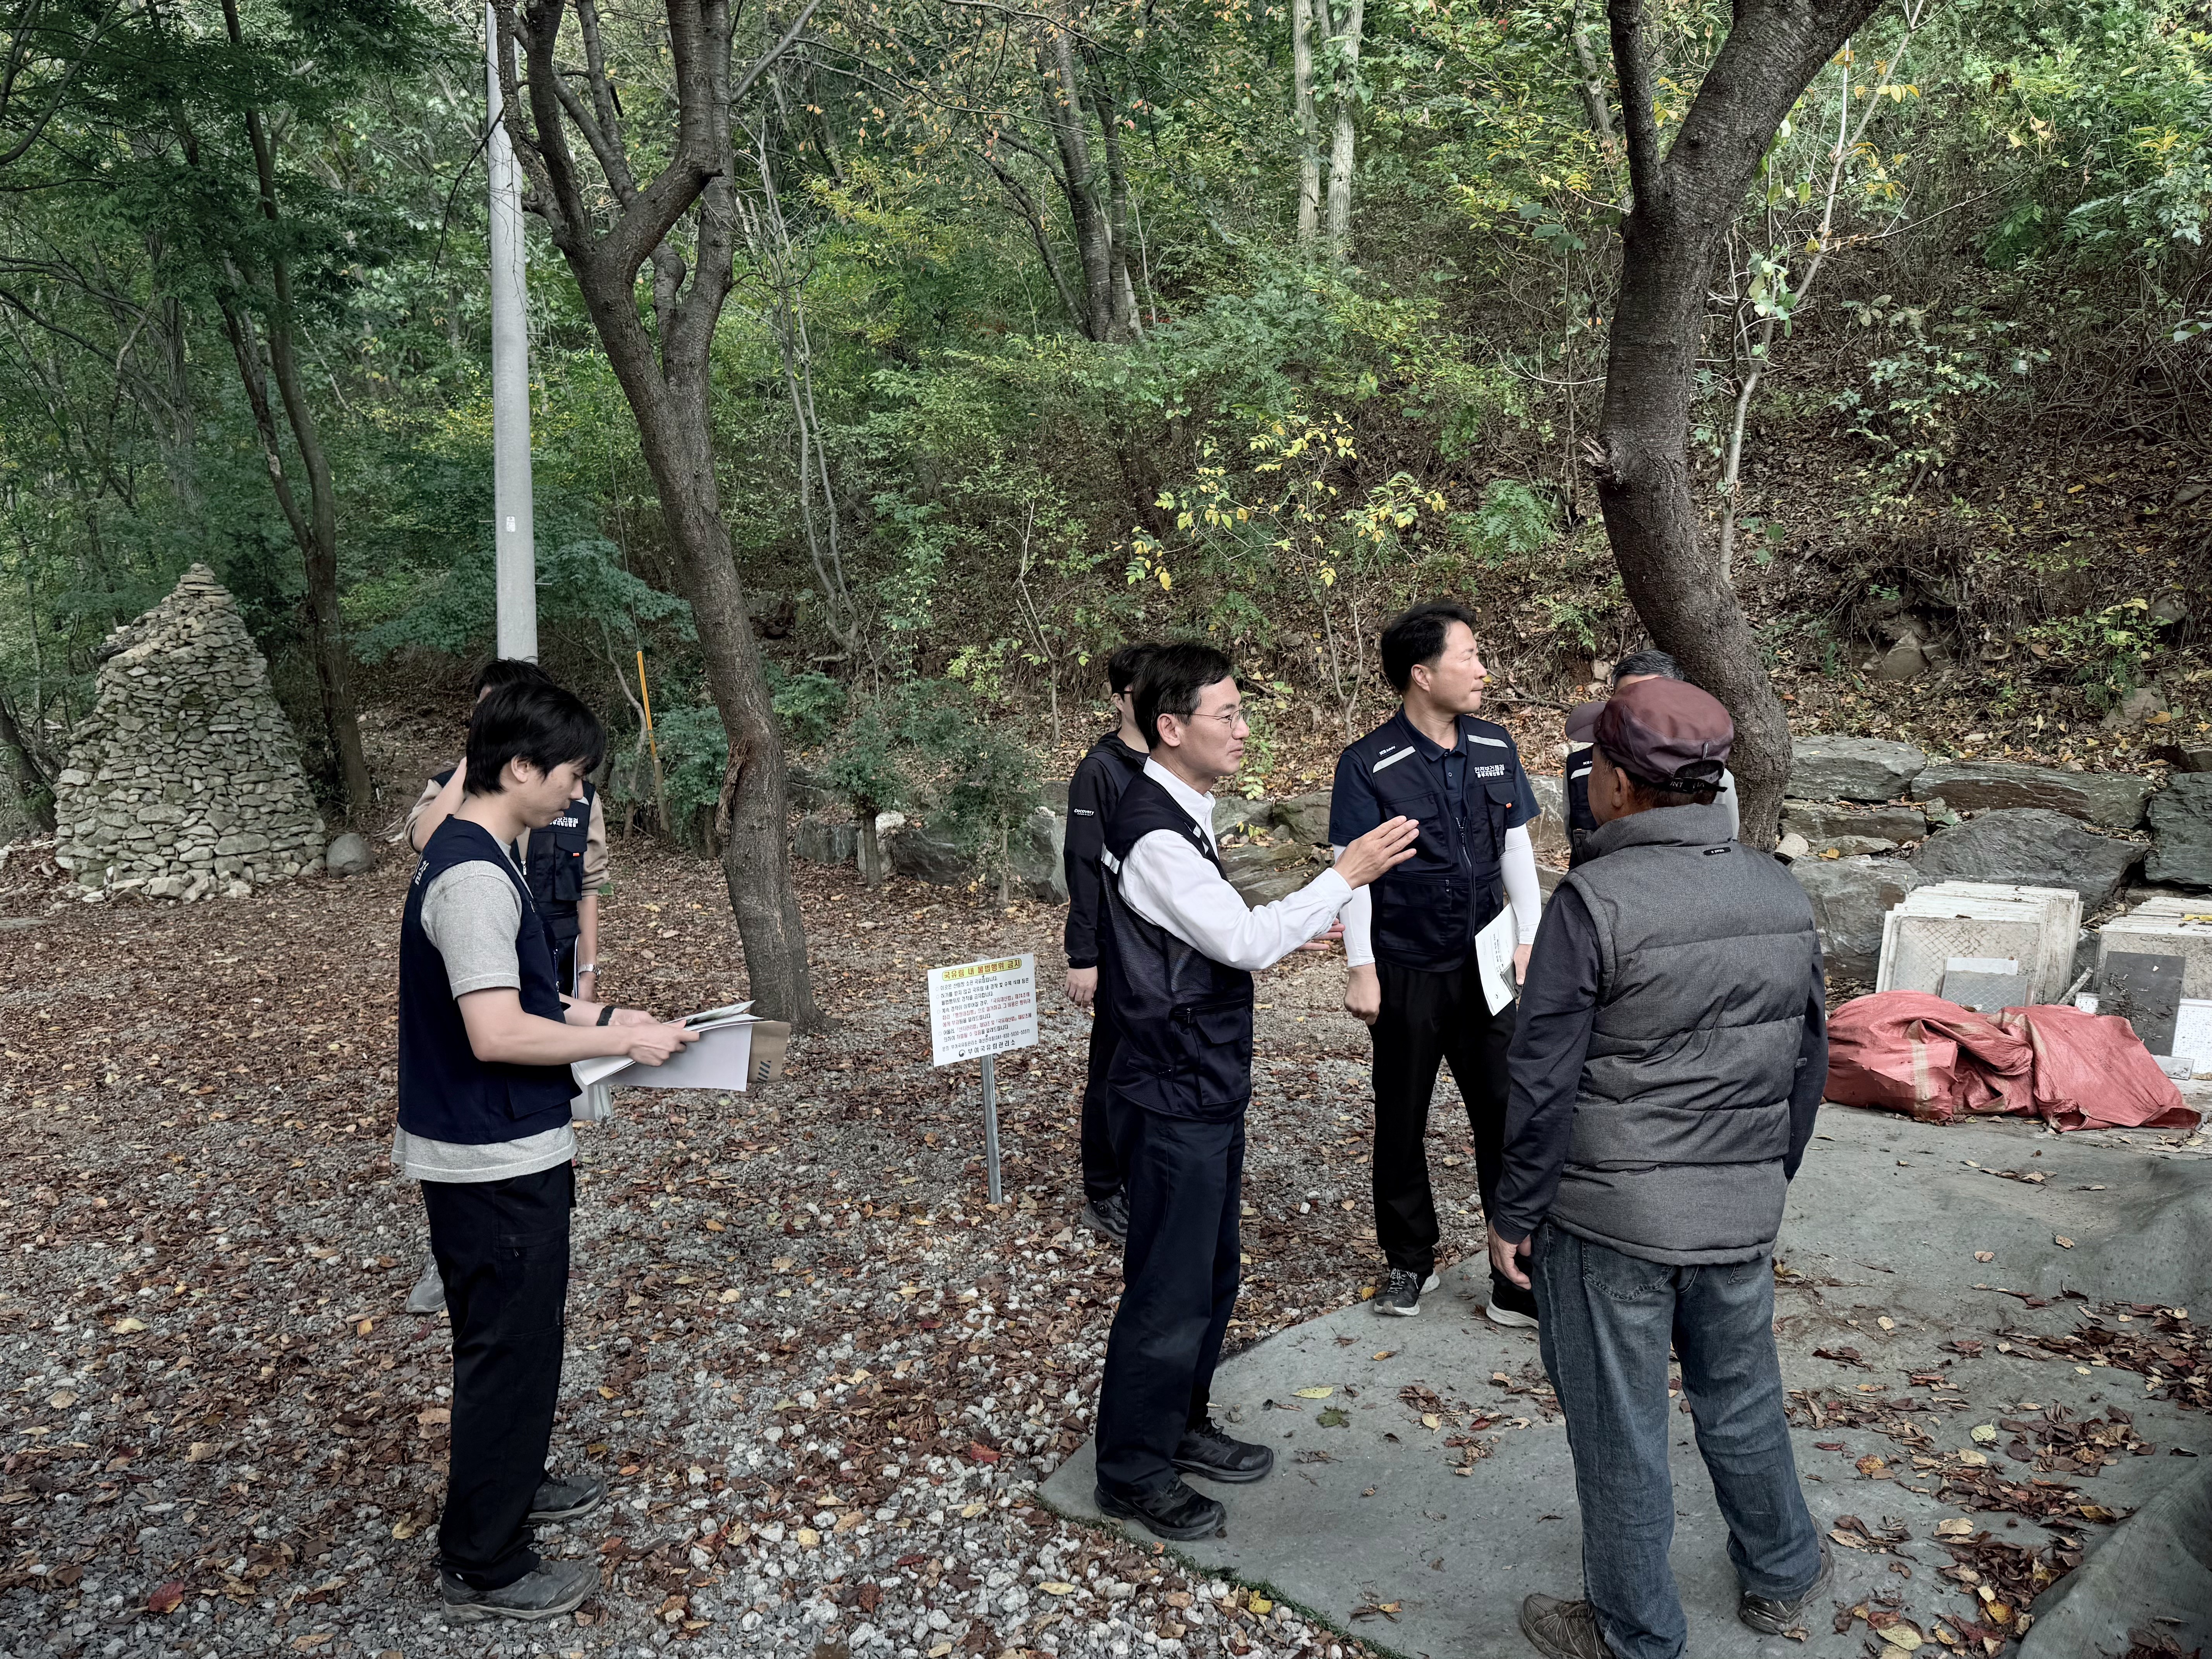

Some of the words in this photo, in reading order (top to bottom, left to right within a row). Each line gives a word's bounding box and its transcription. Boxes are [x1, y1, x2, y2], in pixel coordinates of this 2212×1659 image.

[1474, 764, 1505, 774] 안전보건점검
[944, 969, 964, 979] 국유림
[977, 962, 1004, 973] 불법행위
[1007, 959, 1020, 968] 금지
[968, 1039, 1015, 1054] 부여국유림관리소
